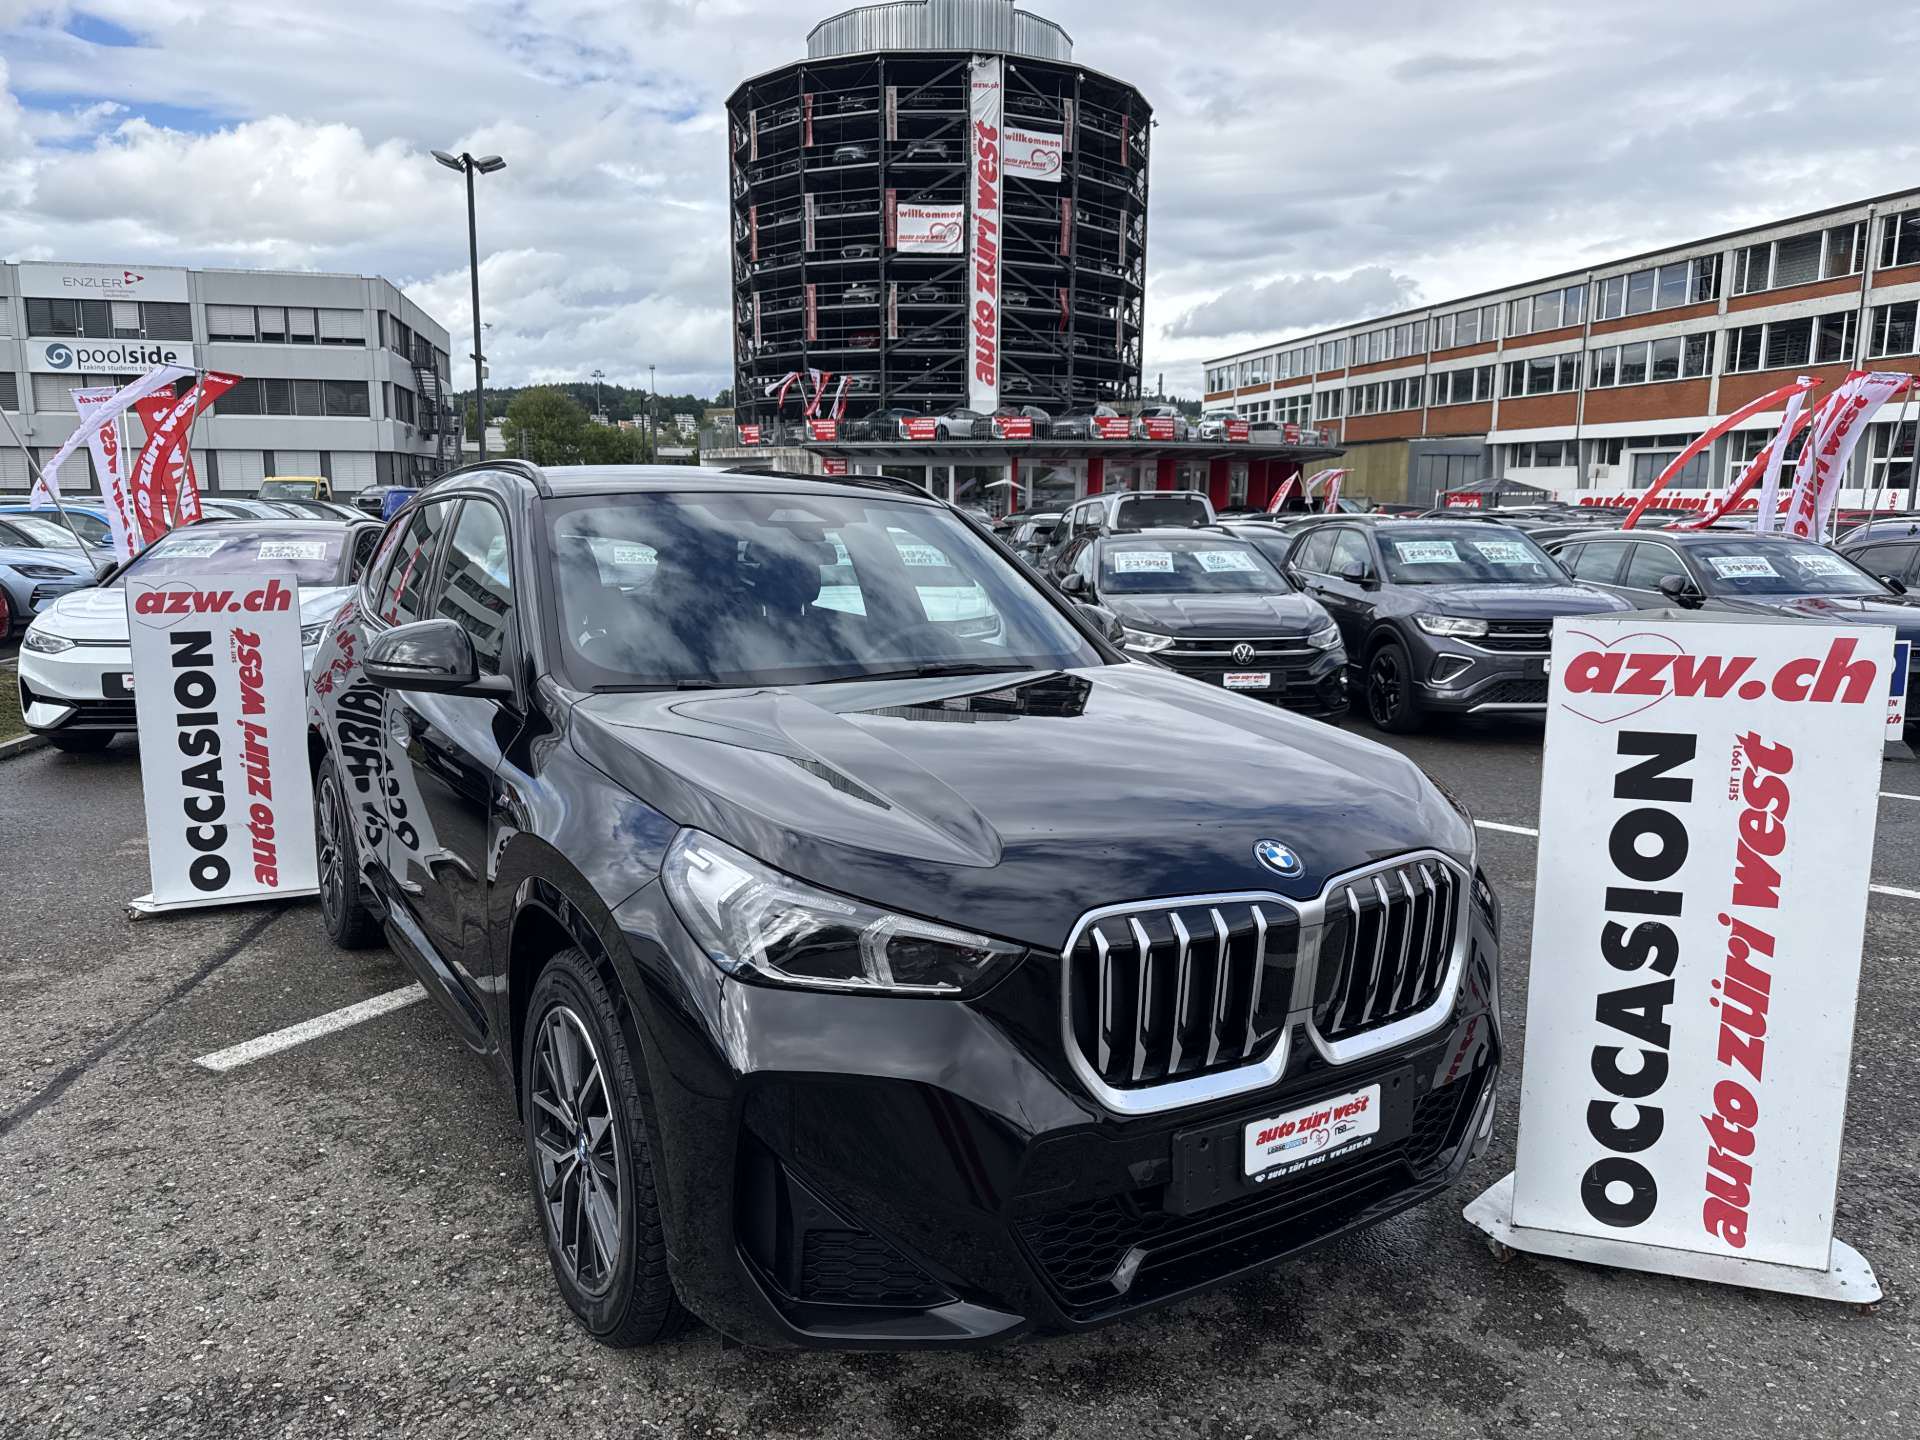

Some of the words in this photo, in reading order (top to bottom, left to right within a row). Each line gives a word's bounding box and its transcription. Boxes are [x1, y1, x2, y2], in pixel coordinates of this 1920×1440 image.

[975, 119, 998, 210] west
[1005, 132, 1060, 148] willkommen
[899, 208, 962, 218] willkommen
[62, 276, 122, 288] ENZLER
[971, 213, 998, 294] züri
[76, 344, 177, 370] poolside
[83, 364, 105, 373] taking
[107, 364, 138, 372] students
[974, 299, 996, 387] auto
[1822, 394, 1869, 456] west
[135, 579, 292, 614] azw.ch
[230, 626, 264, 715] west
[1562, 637, 1878, 704] azw.ch
[169, 631, 231, 892] OCCASION
[237, 717, 272, 801] züri
[1727, 771, 1739, 802] SEIT
[1730, 742, 1747, 771] 1991
[247, 802, 279, 888] auto
[1730, 730, 1795, 910] west
[1580, 730, 1698, 1228] OCCASION
[1709, 911, 1777, 1084] züri
[1255, 1120, 1296, 1146] auto
[1296, 1106, 1333, 1134] züri
[1333, 1095, 1370, 1121] west
[1267, 1167, 1287, 1180] auto
[1288, 1159, 1307, 1173] züri
[1307, 1154, 1327, 1167] west
[1699, 1079, 1760, 1249] auto
